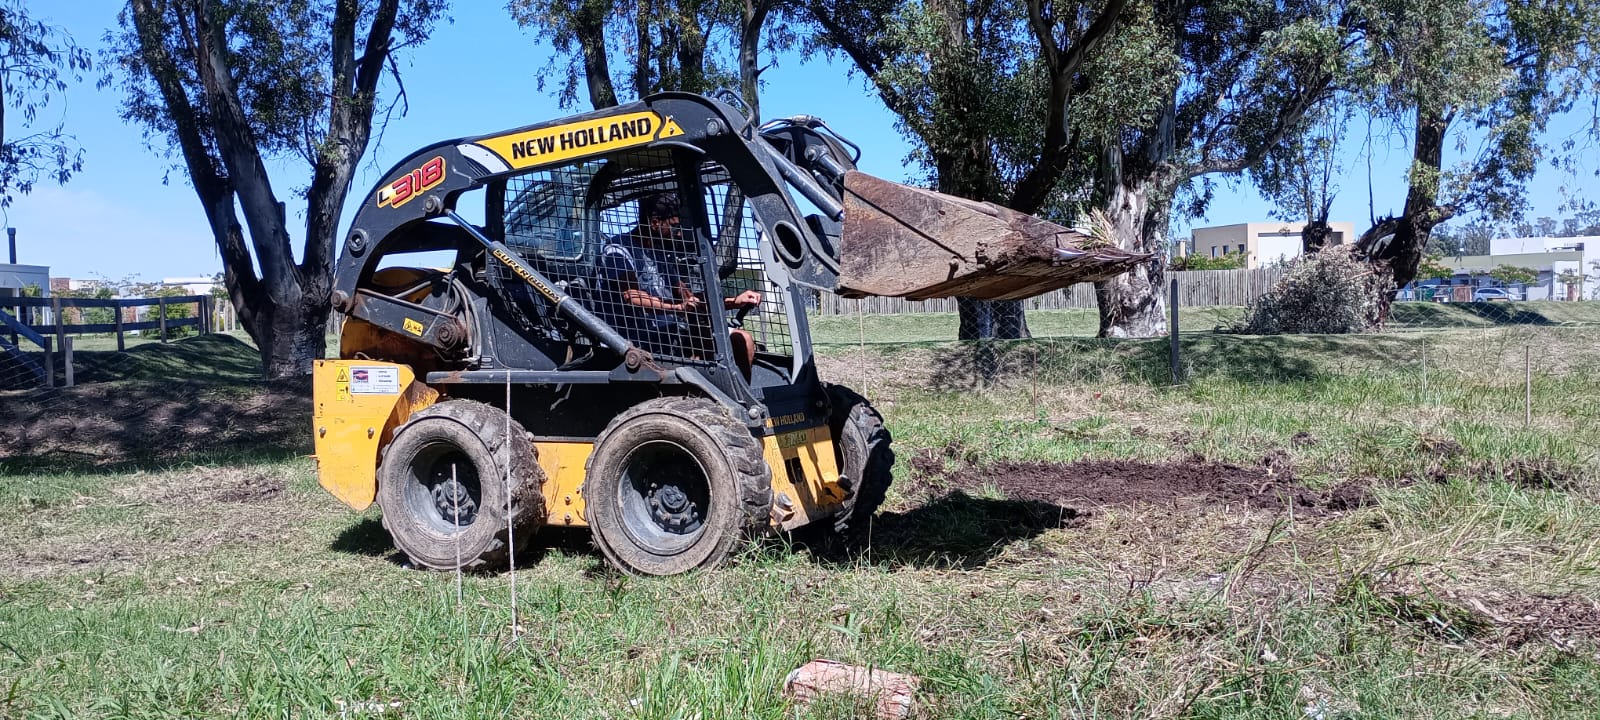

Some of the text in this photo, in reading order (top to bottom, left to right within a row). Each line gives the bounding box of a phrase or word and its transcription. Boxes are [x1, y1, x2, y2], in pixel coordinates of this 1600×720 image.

[511, 117, 652, 160] NEW HOLLAND
[378, 156, 445, 207] L318
